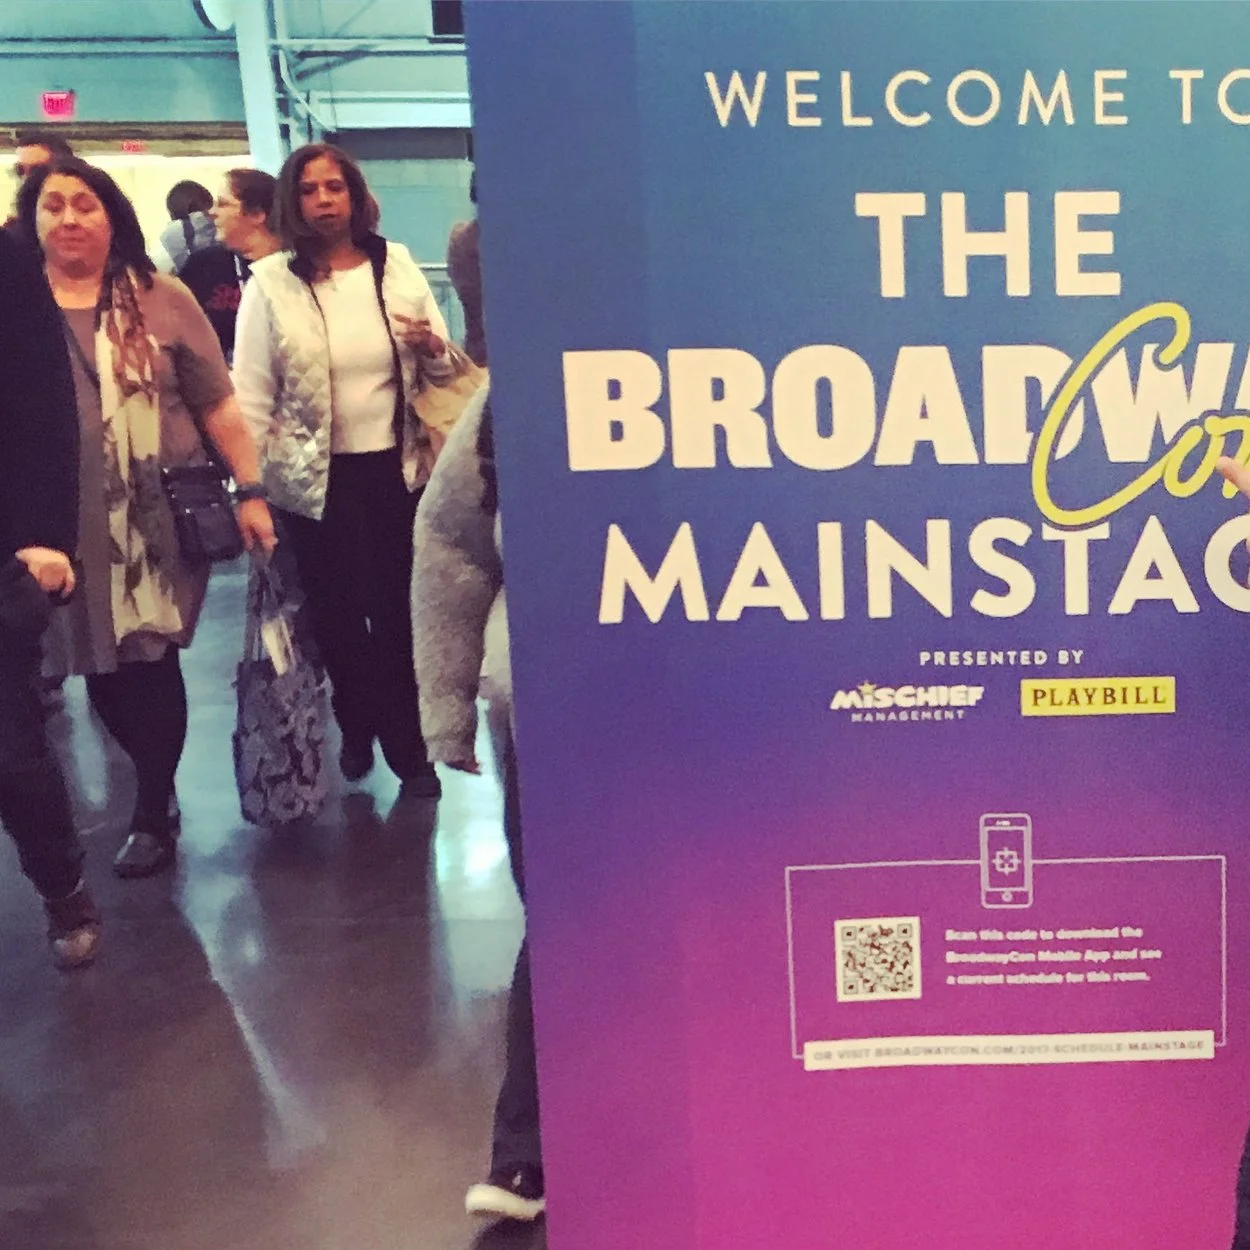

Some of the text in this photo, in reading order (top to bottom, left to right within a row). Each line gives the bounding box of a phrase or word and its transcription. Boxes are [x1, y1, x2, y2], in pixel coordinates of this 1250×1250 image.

[704, 68, 1129, 128] WELCOME
[854, 190, 1122, 298] THE
[919, 649, 1084, 666] PRESENTED BY
[1031, 685, 1167, 707] PLAYBILL
[851, 709, 965, 723] MANAGEMENT
